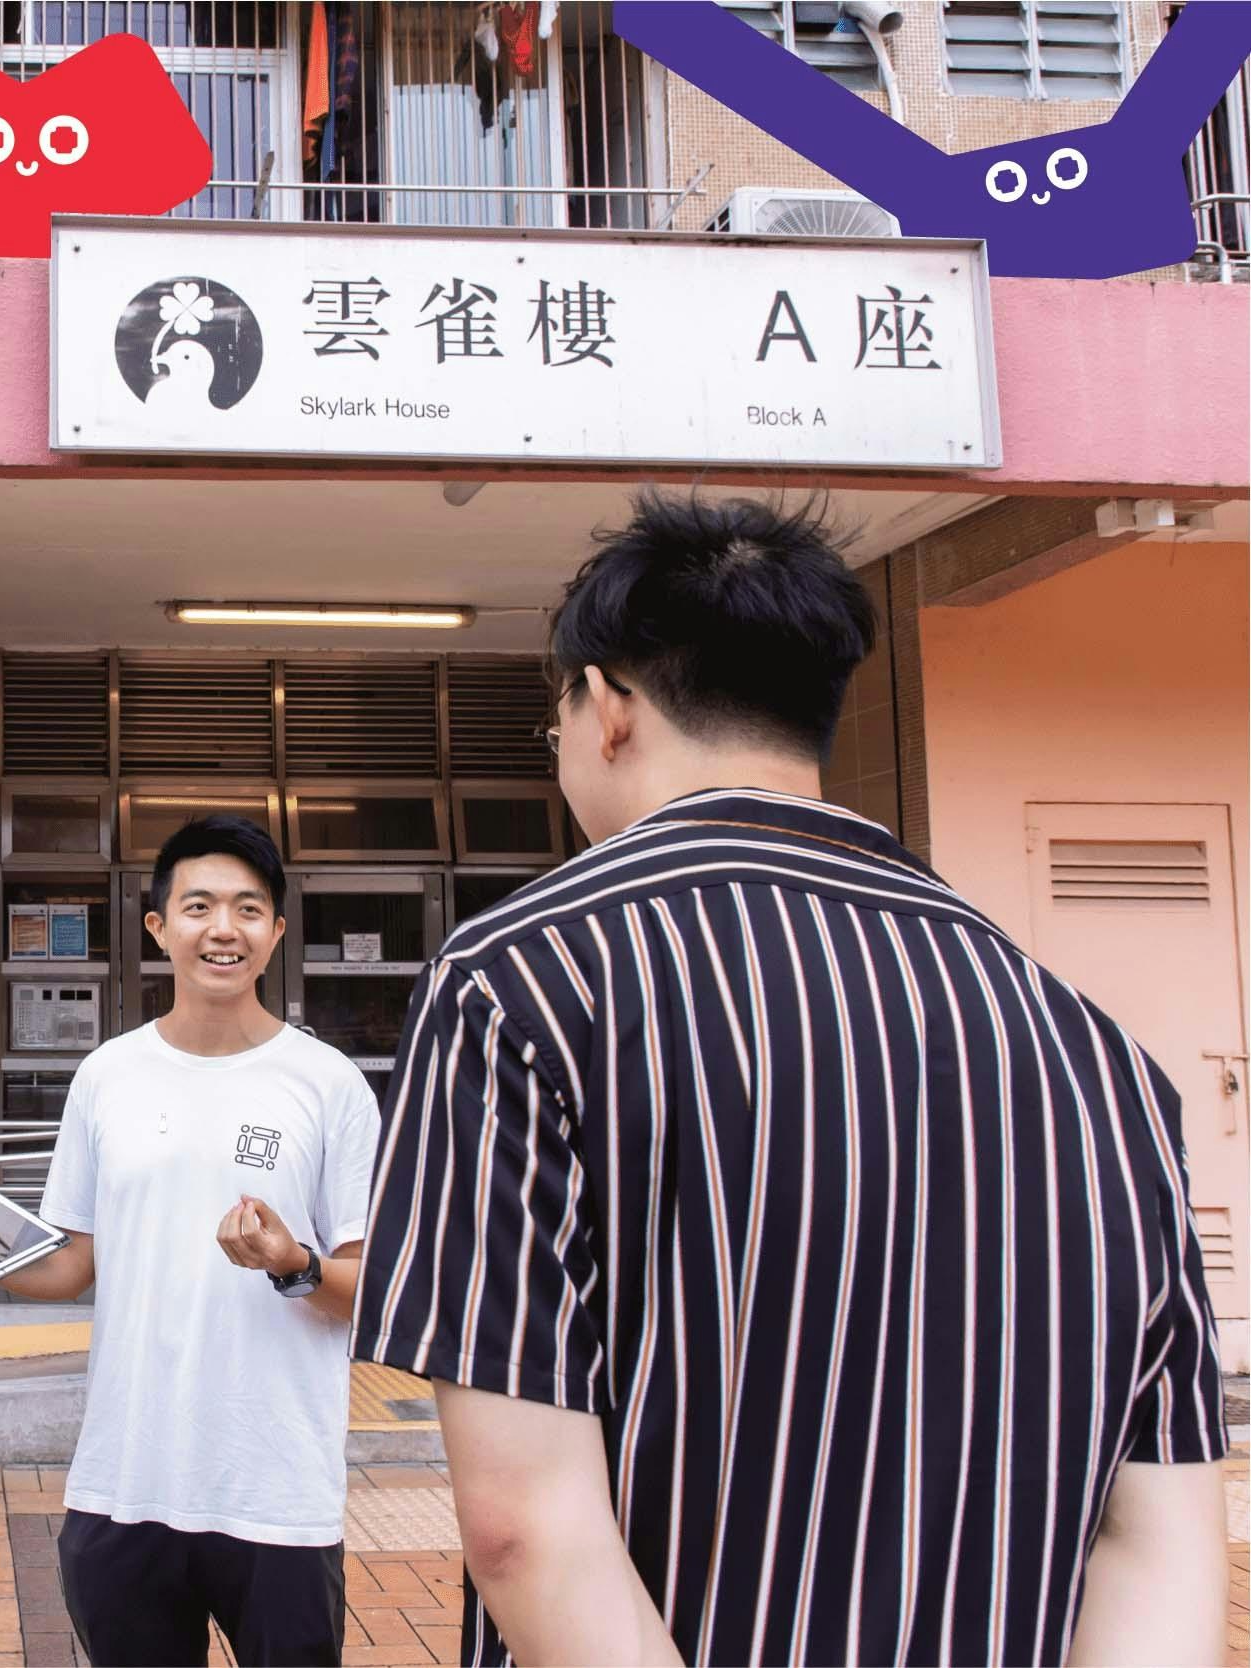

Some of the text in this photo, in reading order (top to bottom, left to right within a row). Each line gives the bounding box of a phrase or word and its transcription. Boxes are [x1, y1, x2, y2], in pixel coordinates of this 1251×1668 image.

[301, 275, 617, 369] 雲雀樓
[300, 395, 451, 420] Skylark House
[746, 405, 828, 427] Block A
